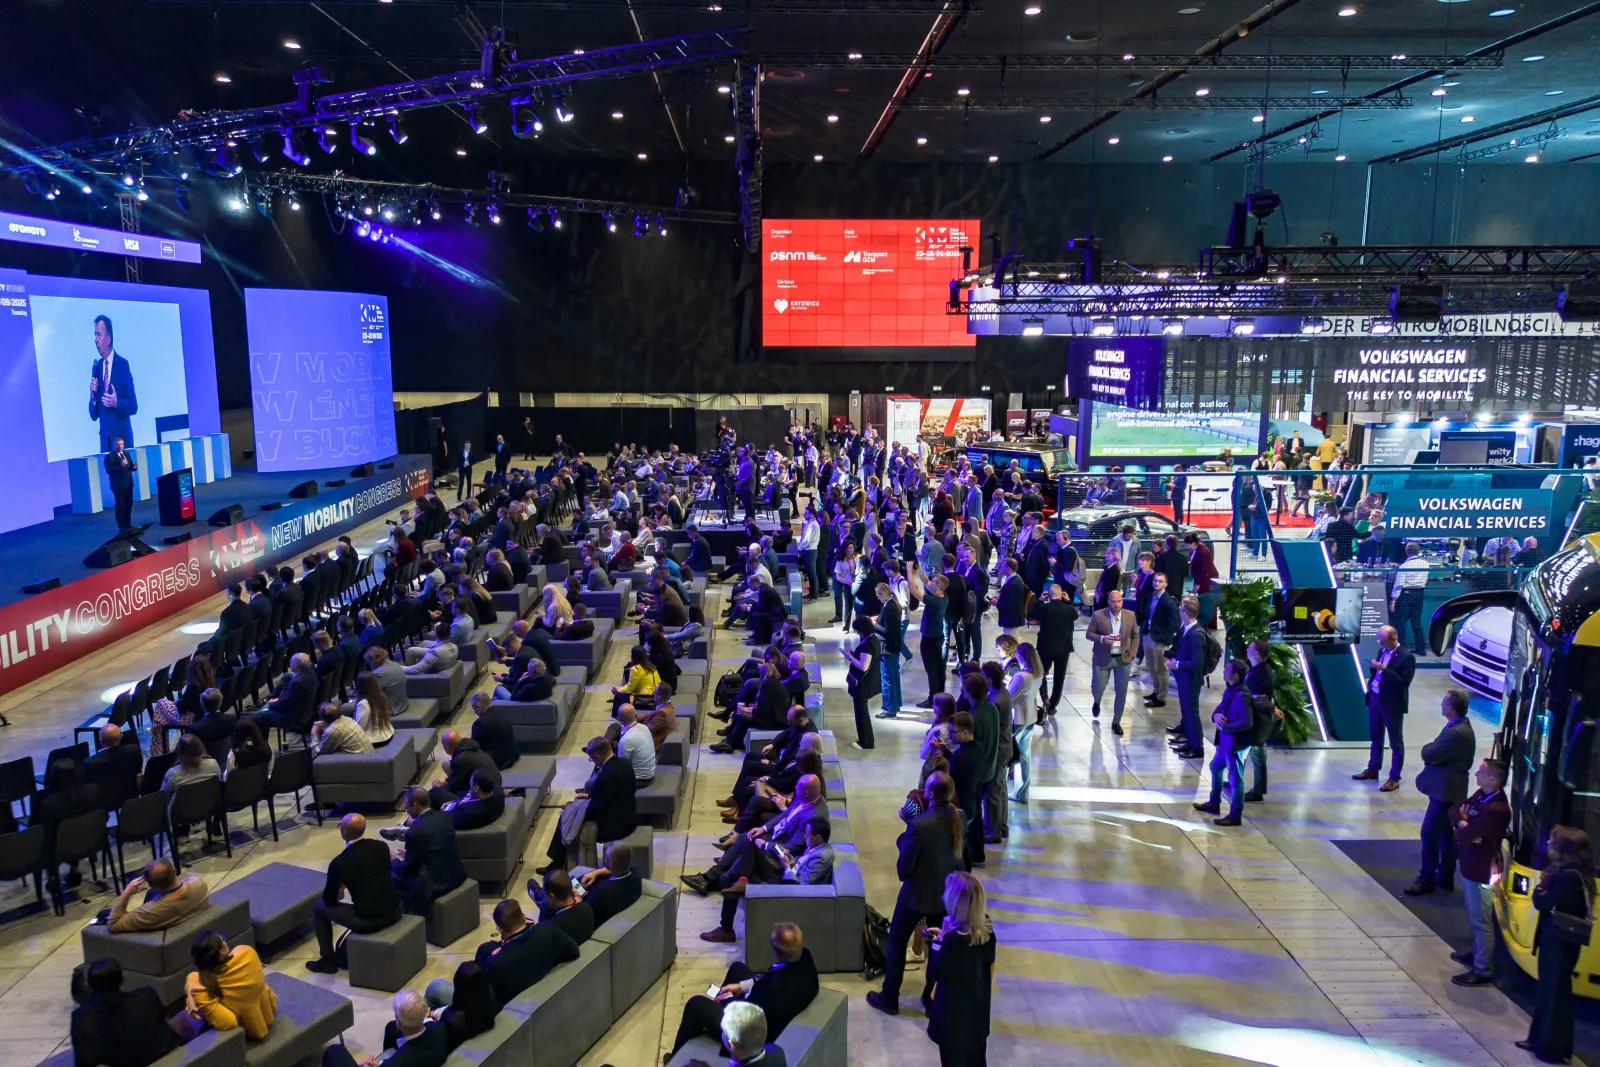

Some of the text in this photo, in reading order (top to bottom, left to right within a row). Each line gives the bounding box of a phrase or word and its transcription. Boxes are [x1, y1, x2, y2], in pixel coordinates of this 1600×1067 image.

[9, 223, 46, 237] OTOMOTO
[123, 239, 139, 251] VISA
[770, 251, 806, 262] psnm
[1359, 349, 1467, 364] VOLKSWAGEN
[1333, 368, 1487, 383] FINANCIAL SERVICES
[1347, 390, 1469, 401] THE KEY TO MOBILITY
[1107, 411, 1136, 419] engine
[1117, 419, 1244, 429] well-informed about e-mobility
[1489, 448, 1511, 457] witty
[1419, 498, 1522, 510] VOLKSWAGEN
[271, 516, 302, 550] NEW
[304, 496, 354, 536] MOBILITY
[355, 477, 401, 514] CONGRESS
[1390, 516, 1546, 529] FINANCIAL SERVICES
[0, 558, 200, 669] ILITY CONGRESS
